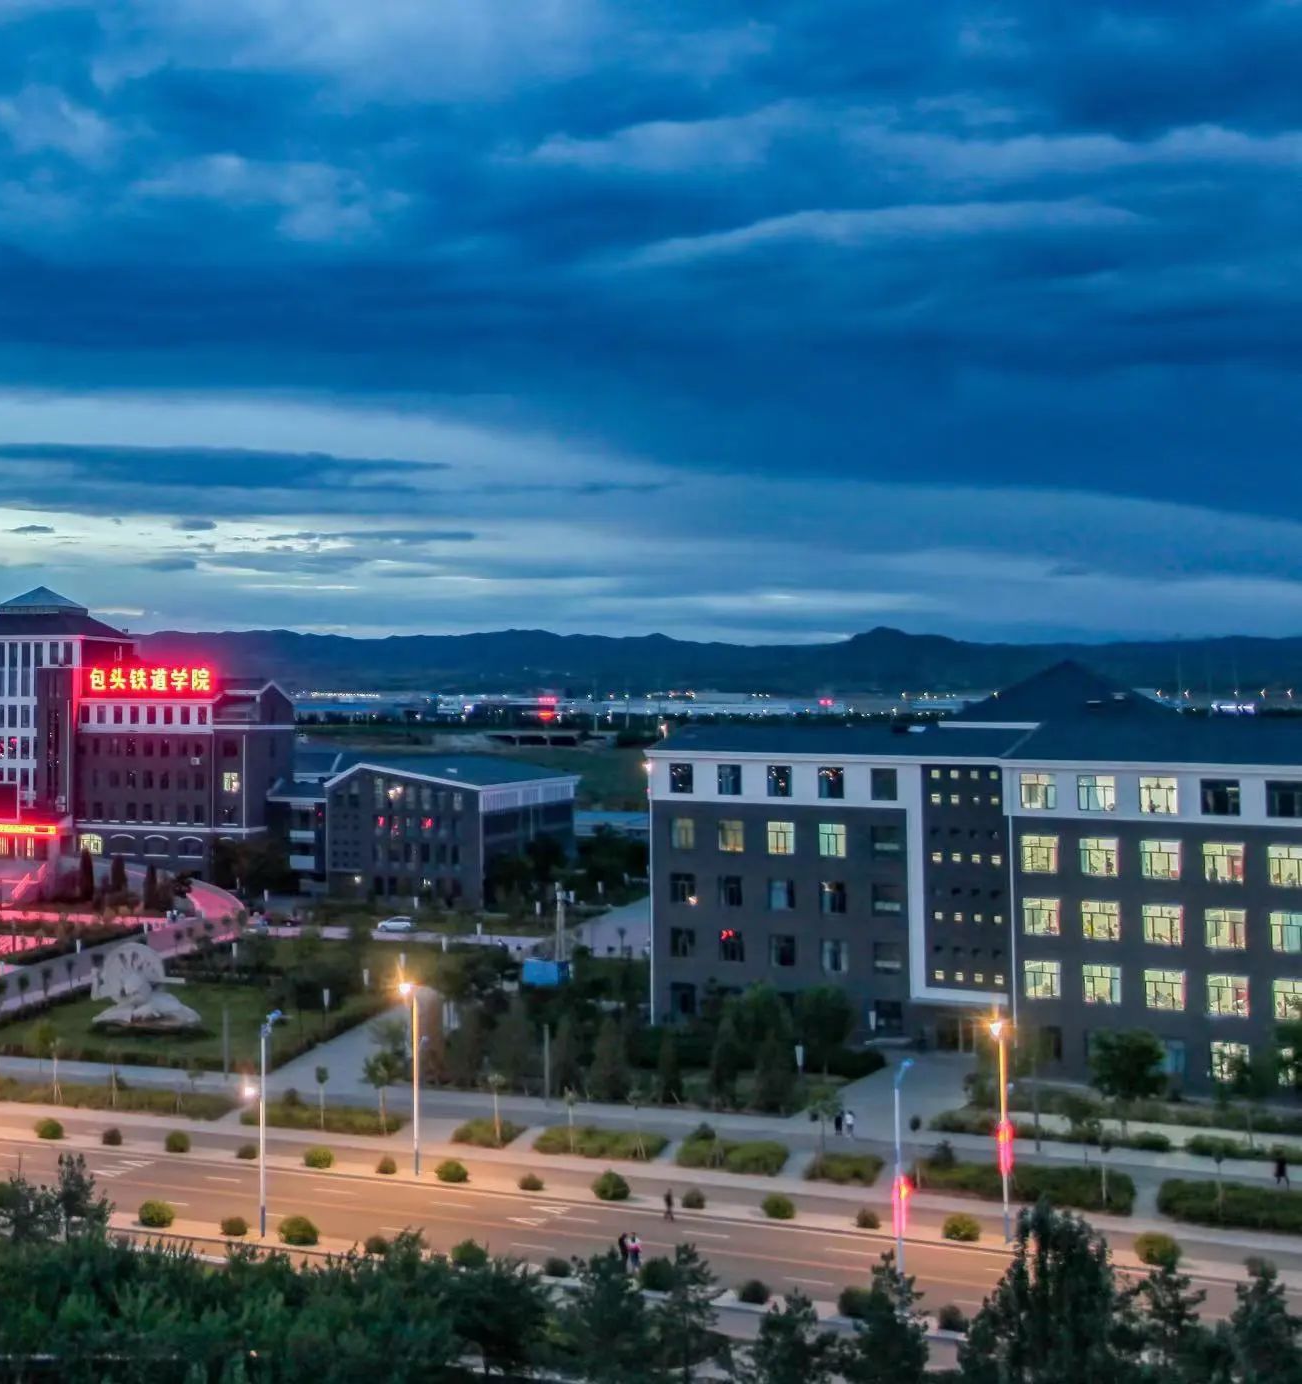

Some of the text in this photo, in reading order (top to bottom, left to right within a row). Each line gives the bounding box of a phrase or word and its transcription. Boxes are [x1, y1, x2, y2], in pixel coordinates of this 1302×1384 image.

[90, 668, 210, 691] 包头铁道学院
